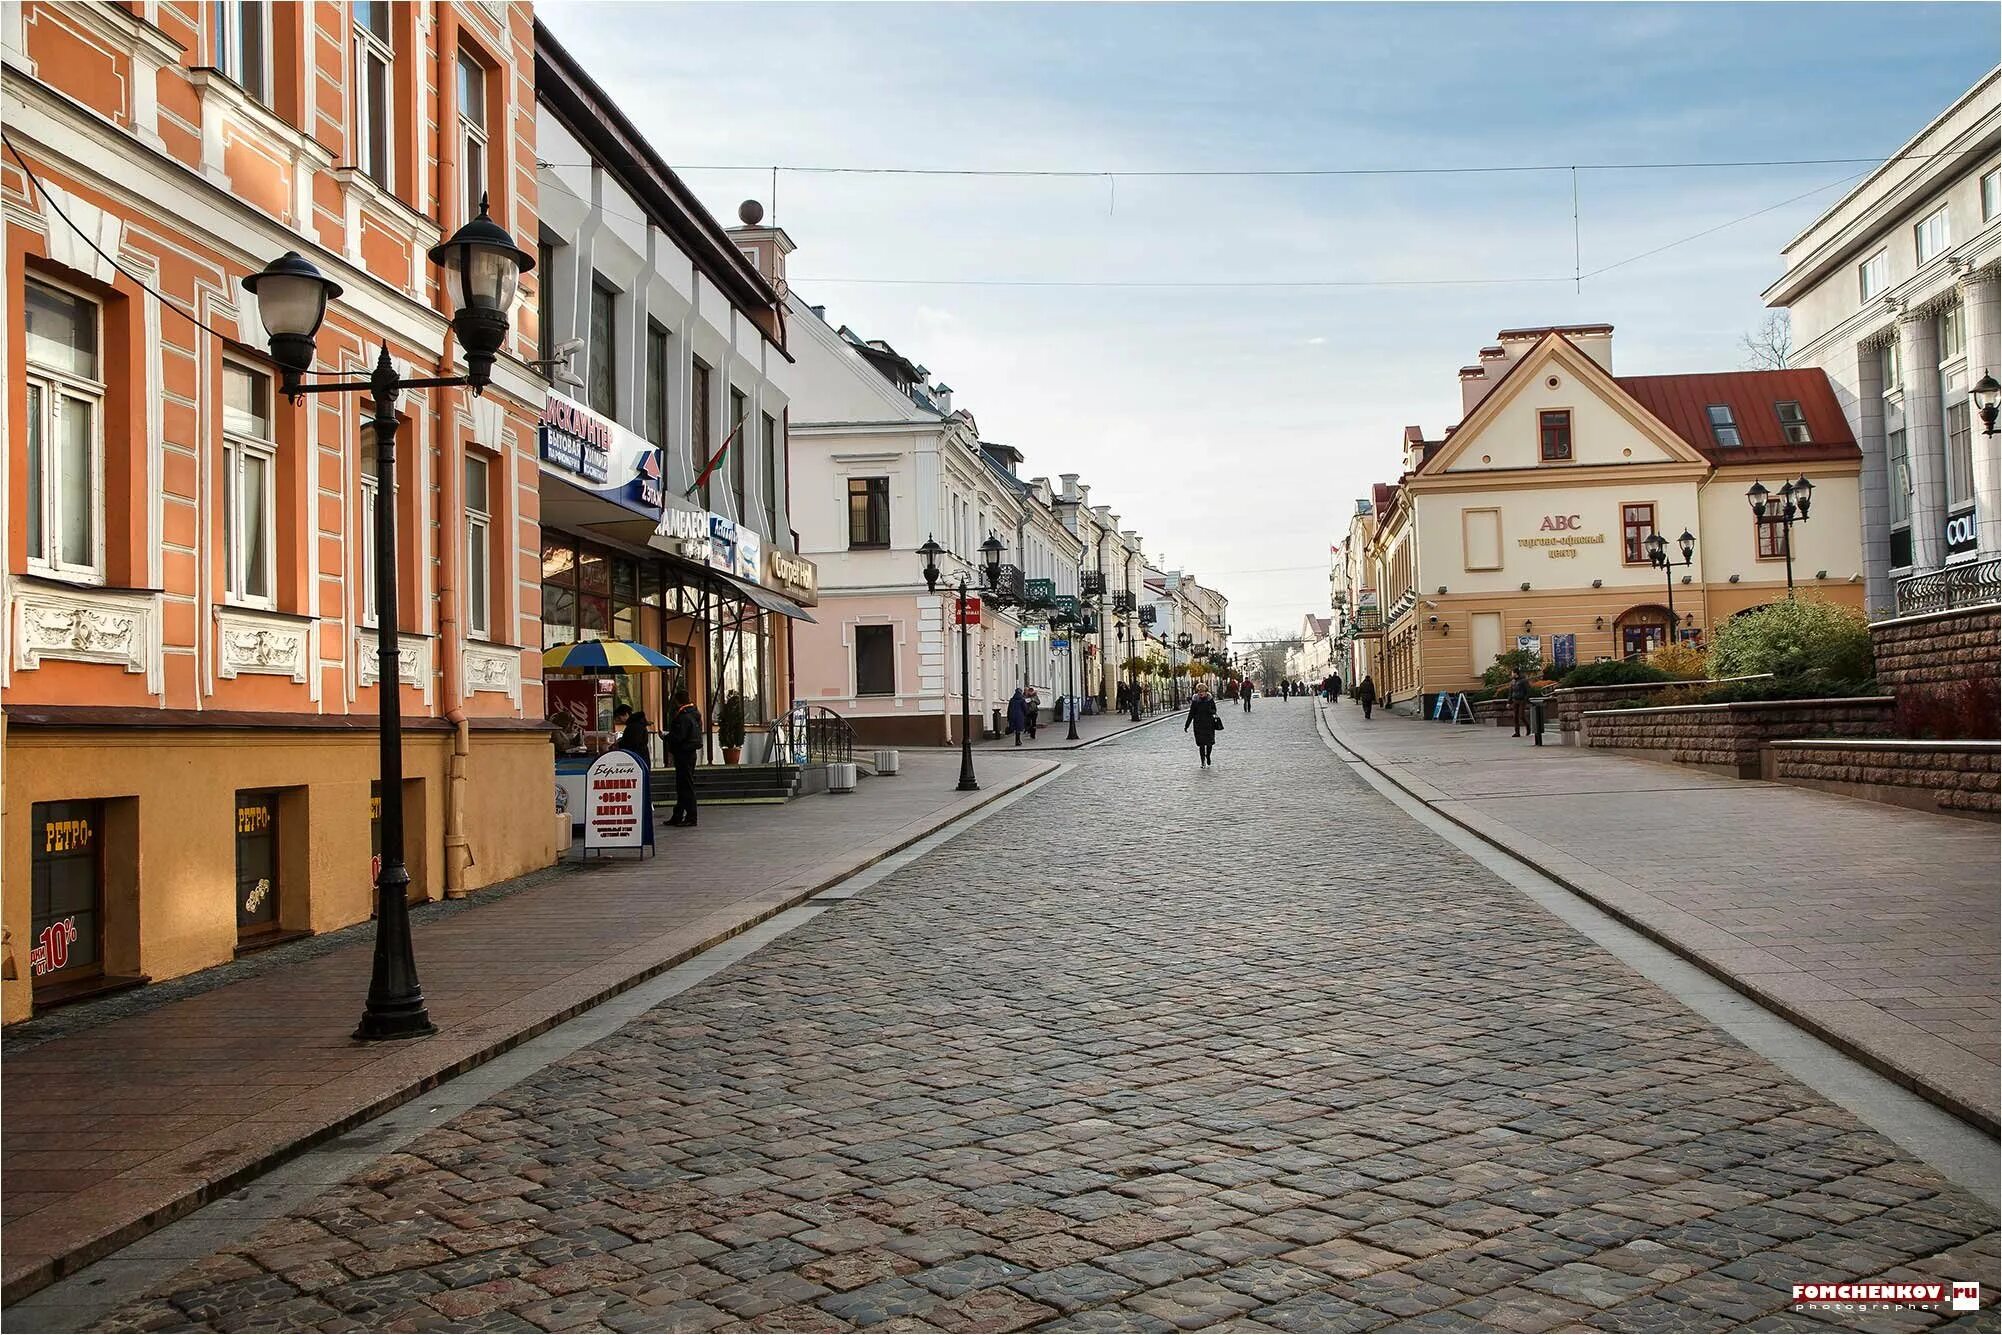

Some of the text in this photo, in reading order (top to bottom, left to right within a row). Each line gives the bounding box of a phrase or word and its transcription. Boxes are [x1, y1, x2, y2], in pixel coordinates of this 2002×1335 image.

[548, 430, 609, 470] БЫТОВАЯ ХИМИЯ
[1540, 515, 1581, 531] ABC
[1518, 534, 1605, 548] торгово-офисный
[1548, 549, 1576, 559] центр
[773, 551, 813, 590] Carpet Hall
[593, 779, 637, 789] ЛАМИНАТ
[596, 805, 633, 815] ПЛИТКА
[40, 916, 77, 972] 10%
